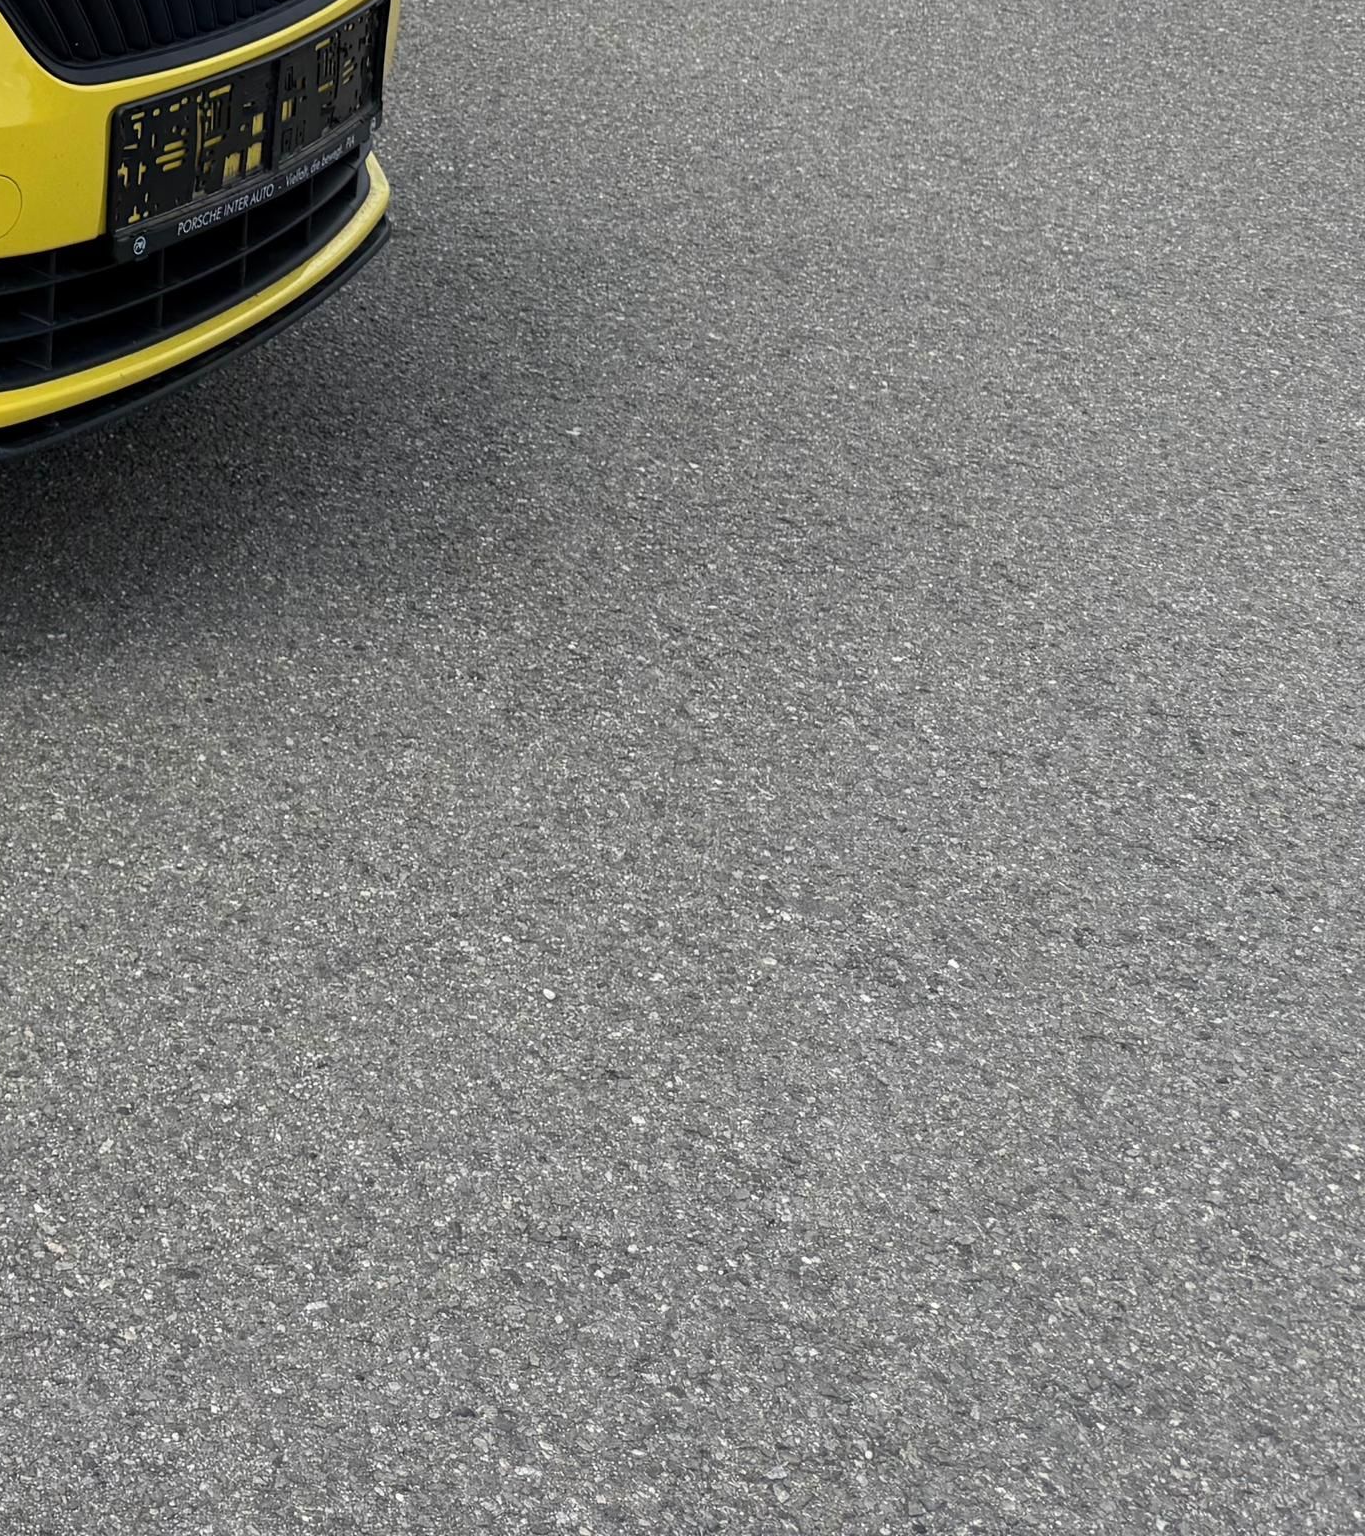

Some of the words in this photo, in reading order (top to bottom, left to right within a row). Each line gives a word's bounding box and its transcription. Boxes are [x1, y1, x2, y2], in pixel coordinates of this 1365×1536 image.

[177, 207, 223, 236] PORSCHE
[223, 195, 248, 217] INTER
[249, 183, 275, 205] AUTO
